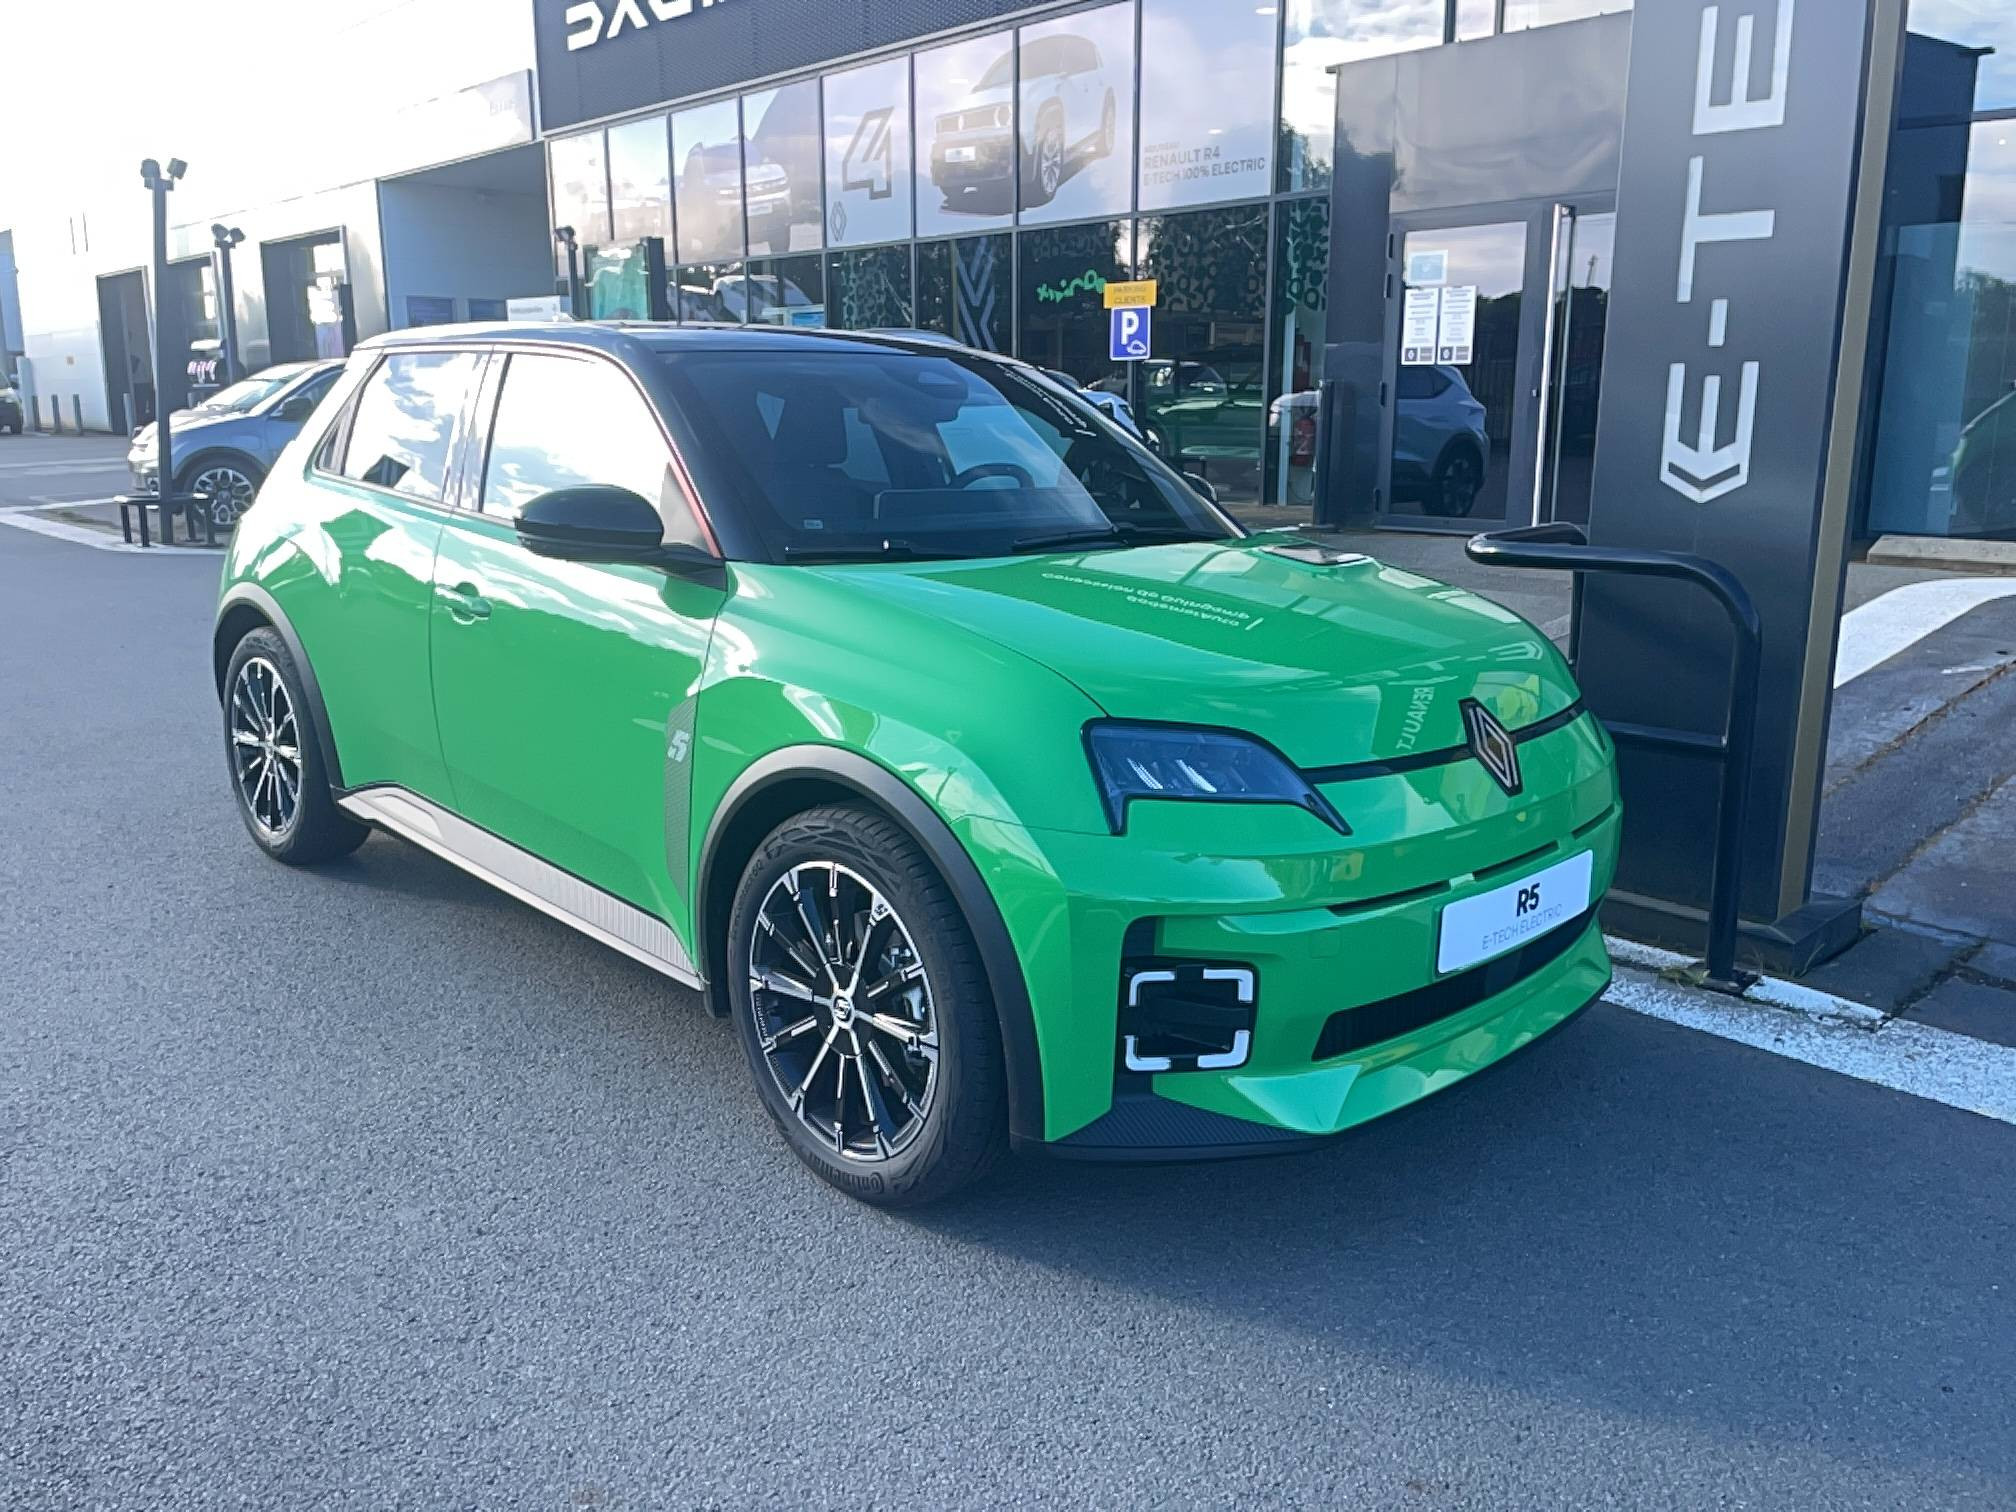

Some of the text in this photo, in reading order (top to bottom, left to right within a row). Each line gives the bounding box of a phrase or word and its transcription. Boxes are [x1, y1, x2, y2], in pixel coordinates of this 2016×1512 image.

[1143, 145, 1221, 170] RENAULT R4
[1182, 164, 1210, 181] 100%
[1211, 156, 1266, 177] ELECTRIC
[1120, 311, 1140, 345] P
[667, 729, 690, 763] 5
[1516, 882, 1541, 918] R5
[1481, 903, 1563, 951] E-TECH ELECTRIC
